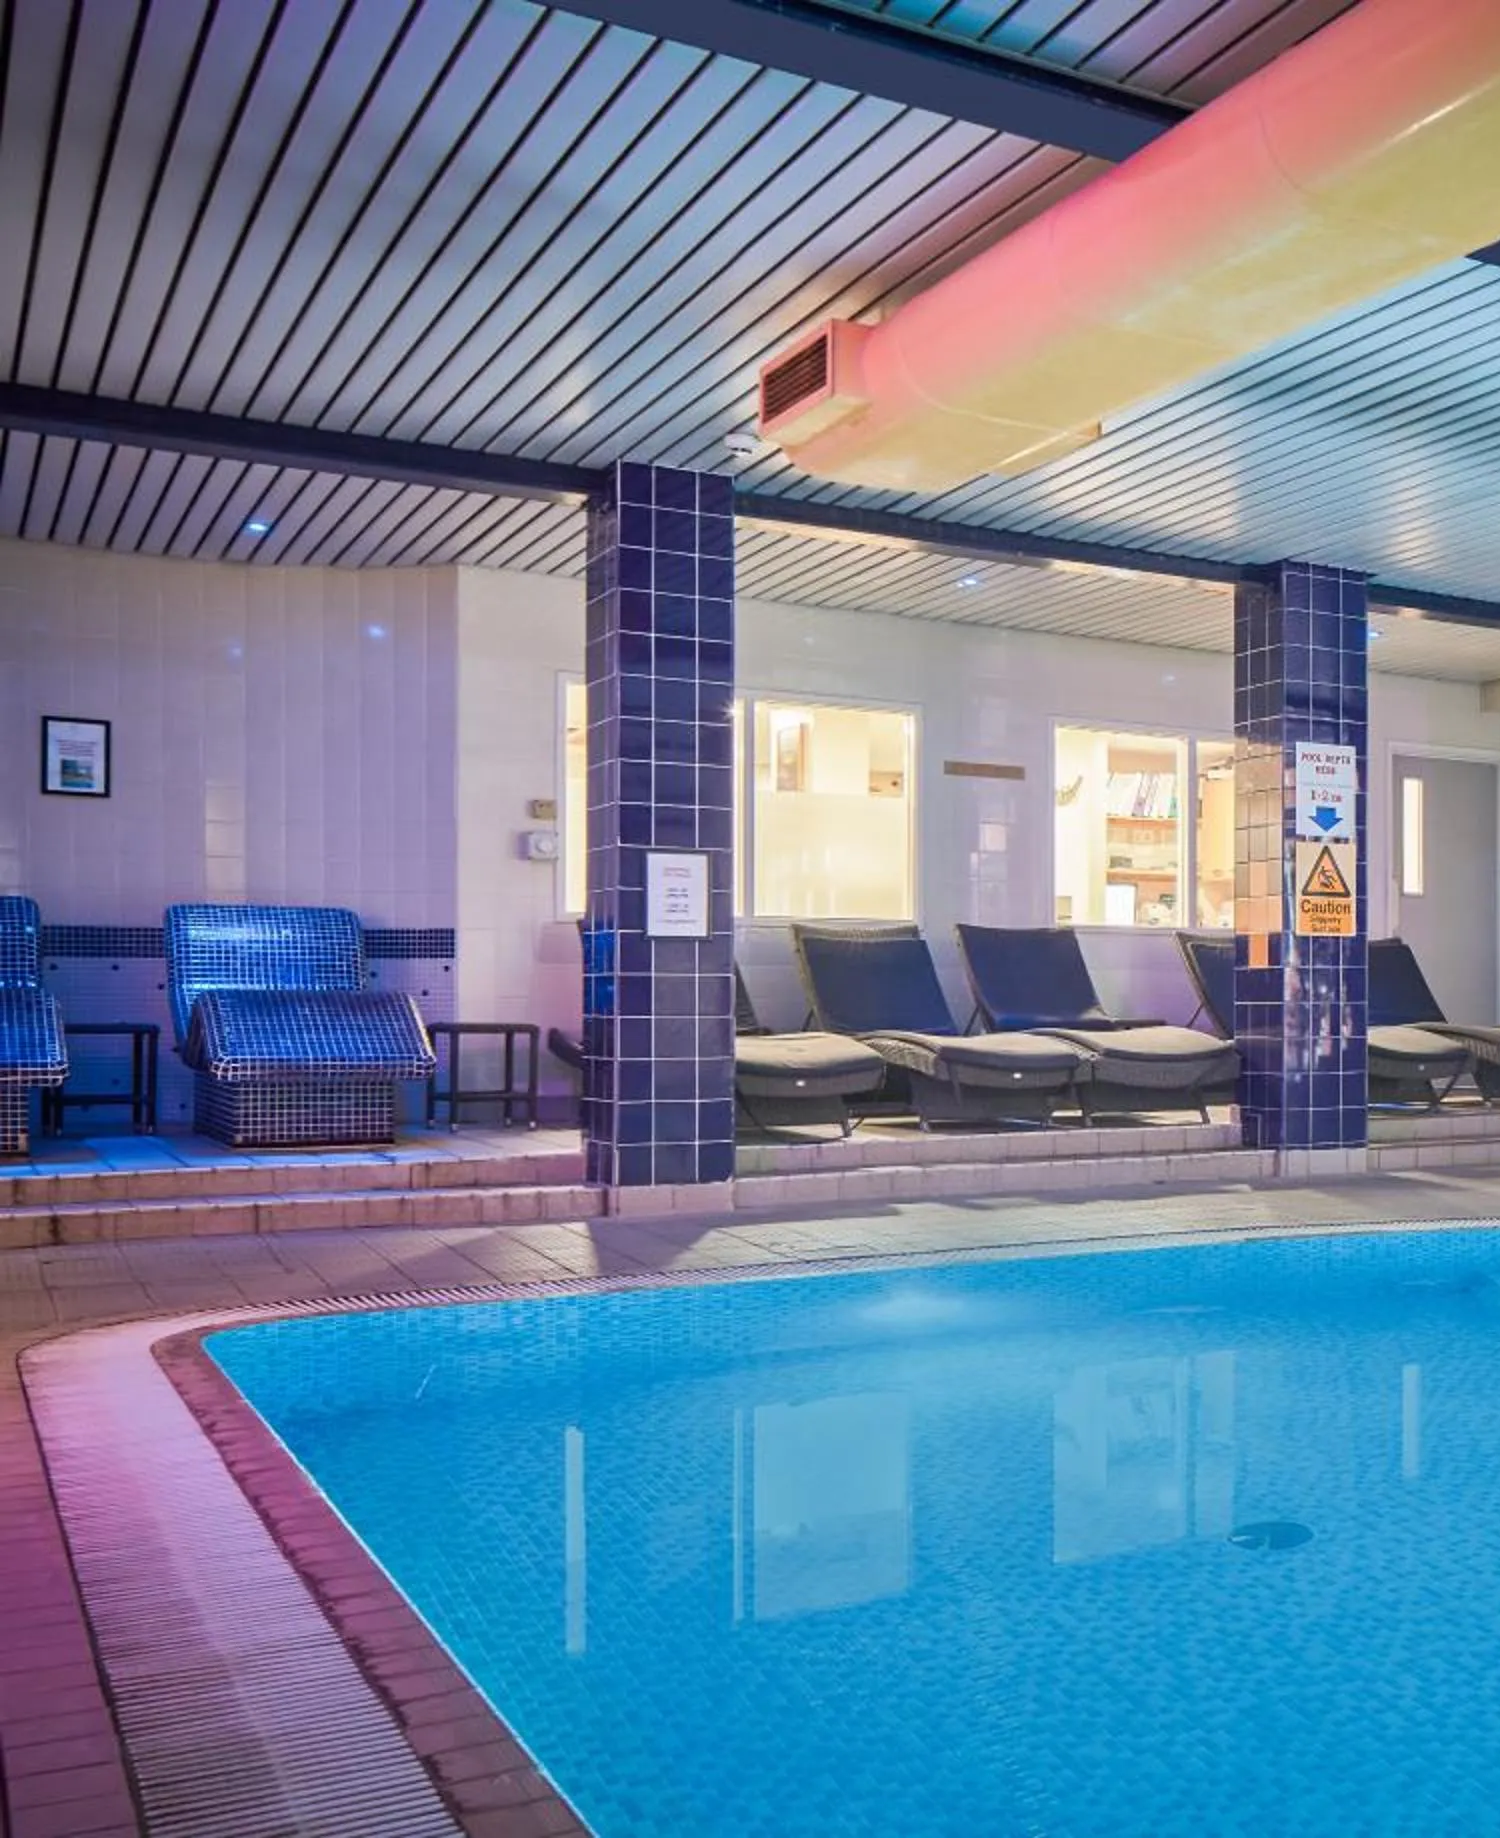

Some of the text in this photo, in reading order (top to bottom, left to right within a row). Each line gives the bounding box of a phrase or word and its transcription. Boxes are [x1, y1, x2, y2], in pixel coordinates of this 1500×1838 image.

[1301, 752, 1351, 765] POOL DEPTH
[1301, 899, 1351, 915] Caution
